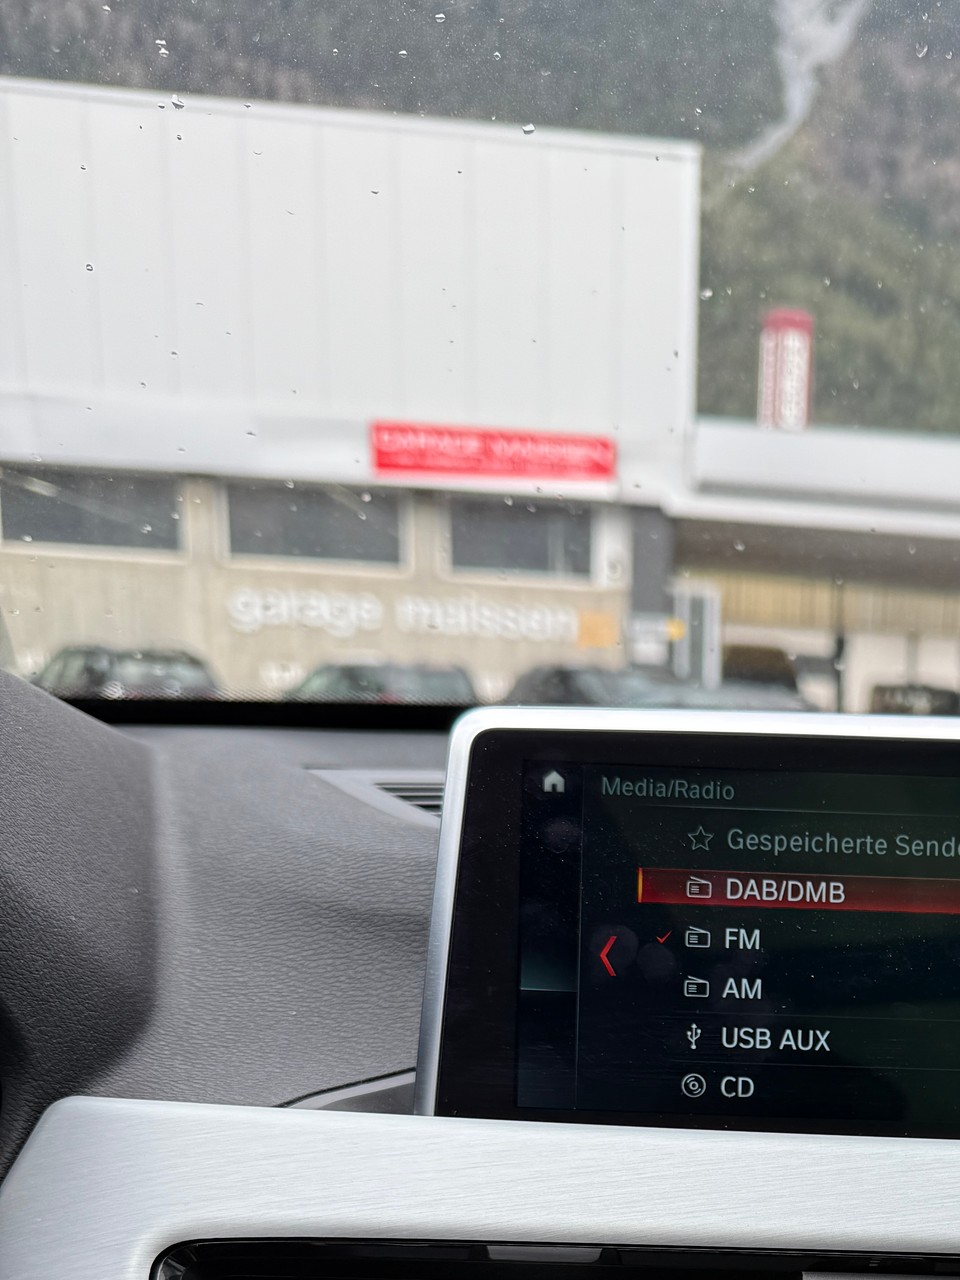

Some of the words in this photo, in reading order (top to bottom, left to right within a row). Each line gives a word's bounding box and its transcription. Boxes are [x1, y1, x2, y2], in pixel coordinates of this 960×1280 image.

[230, 588, 383, 636] garage
[602, 777, 734, 801] Media/Radio
[727, 829, 887, 856] Gespeicherte
[726, 877, 845, 904] DAB/DMB
[725, 928, 761, 950] FM
[722, 978, 762, 1000] AM
[721, 1027, 771, 1049] USB
[779, 1030, 830, 1051] AUX
[720, 1076, 755, 1098] CD
